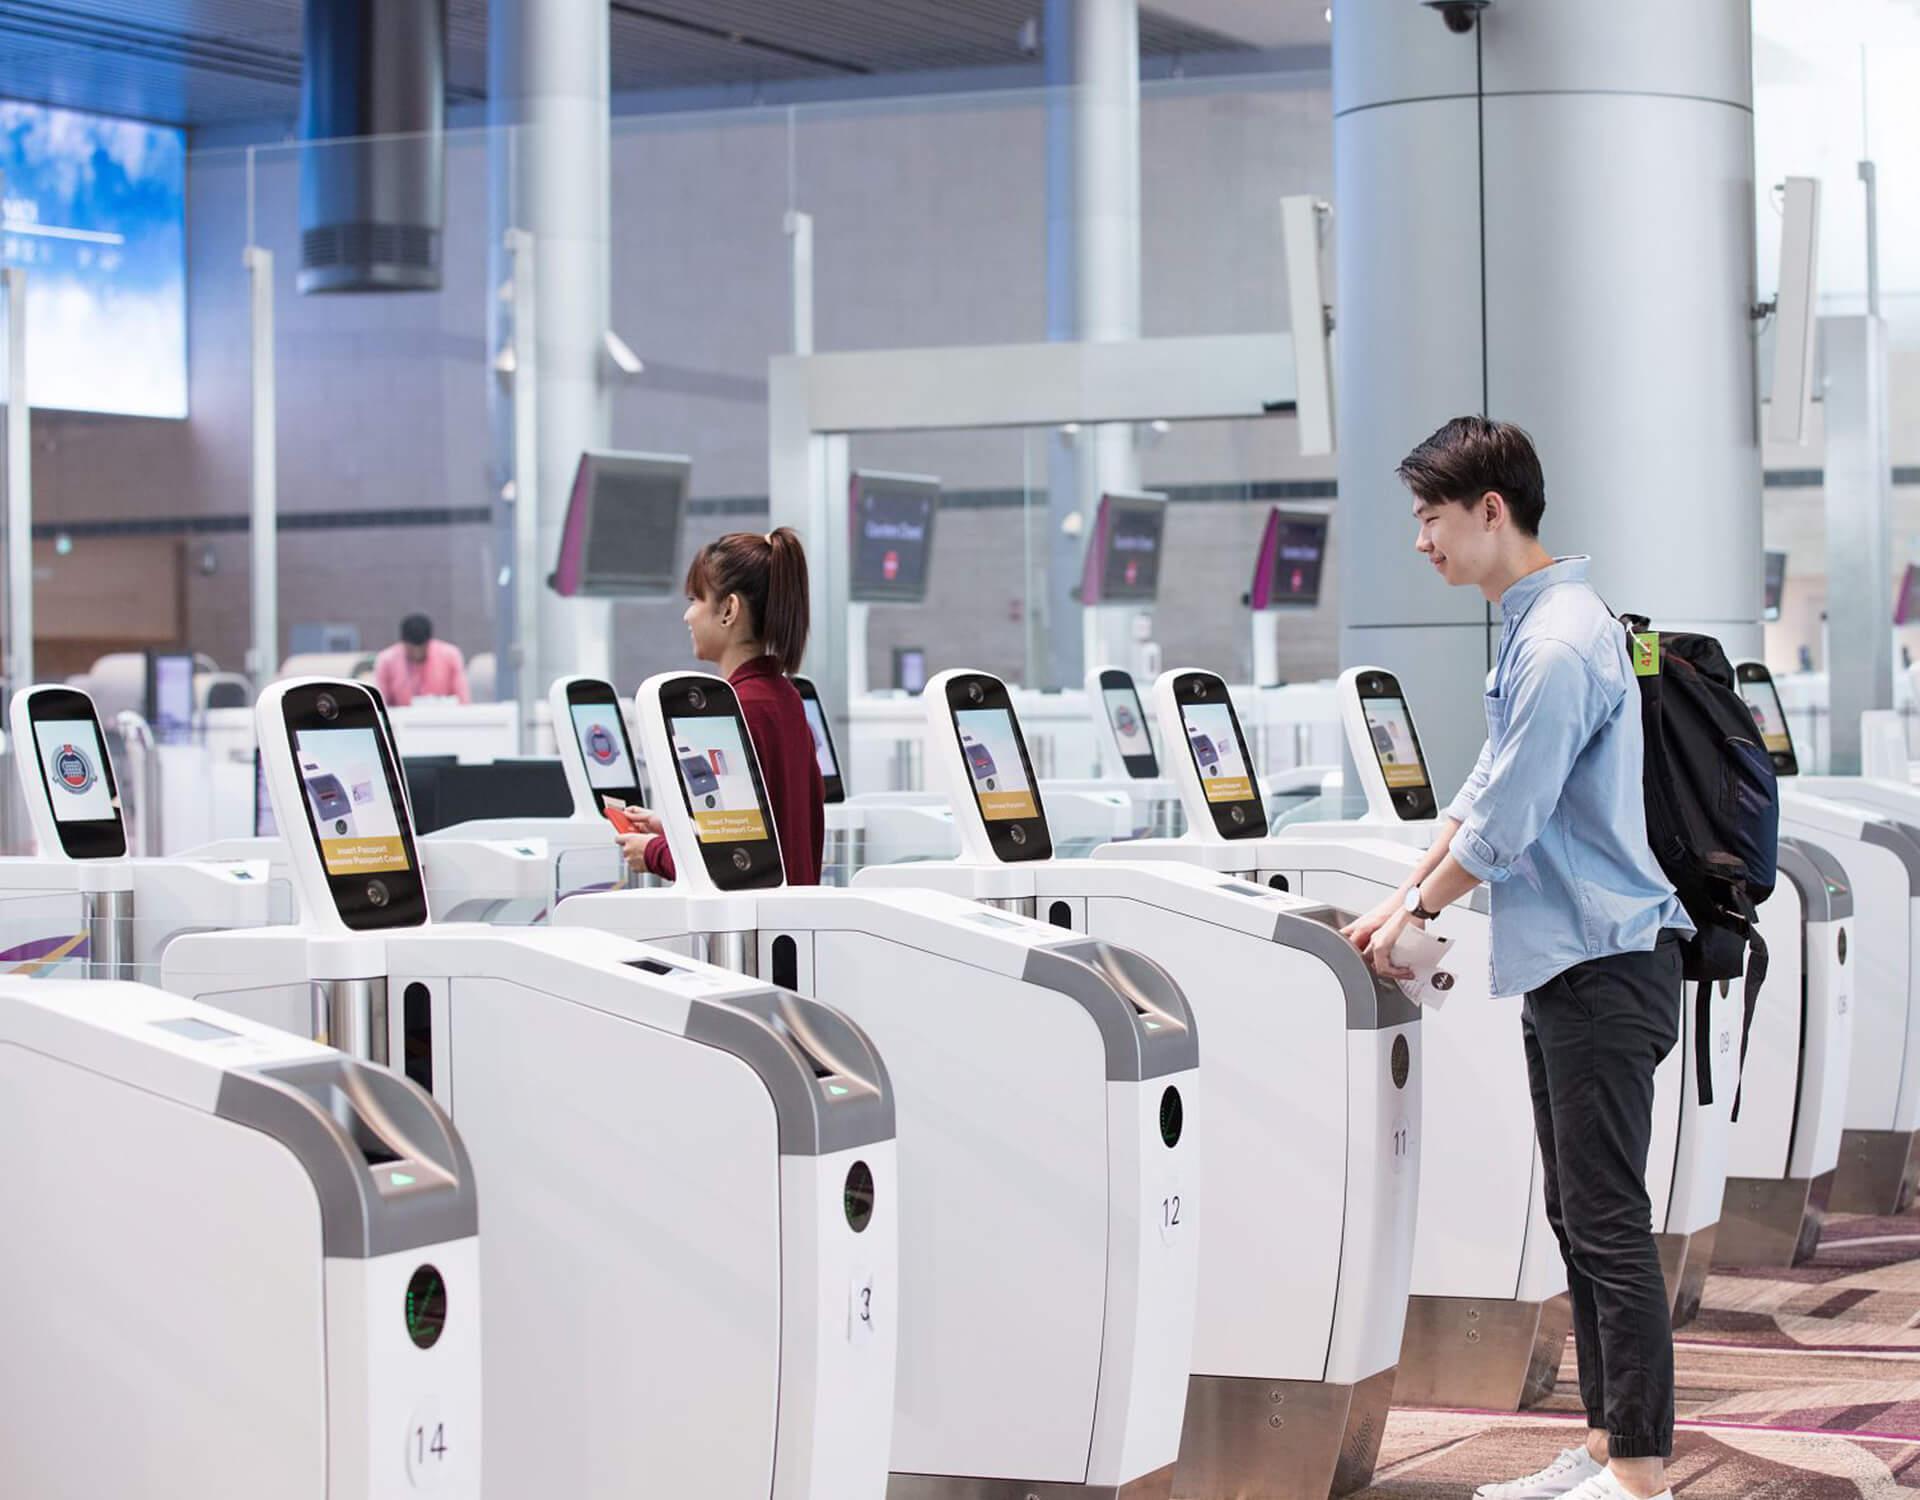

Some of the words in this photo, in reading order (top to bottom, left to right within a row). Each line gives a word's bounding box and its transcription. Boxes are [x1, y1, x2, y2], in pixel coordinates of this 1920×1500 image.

[1393, 1129, 1406, 1156] 11
[1162, 1196, 1180, 1228] 12
[860, 1287, 871, 1321] 3
[416, 1421, 448, 1464] 14
